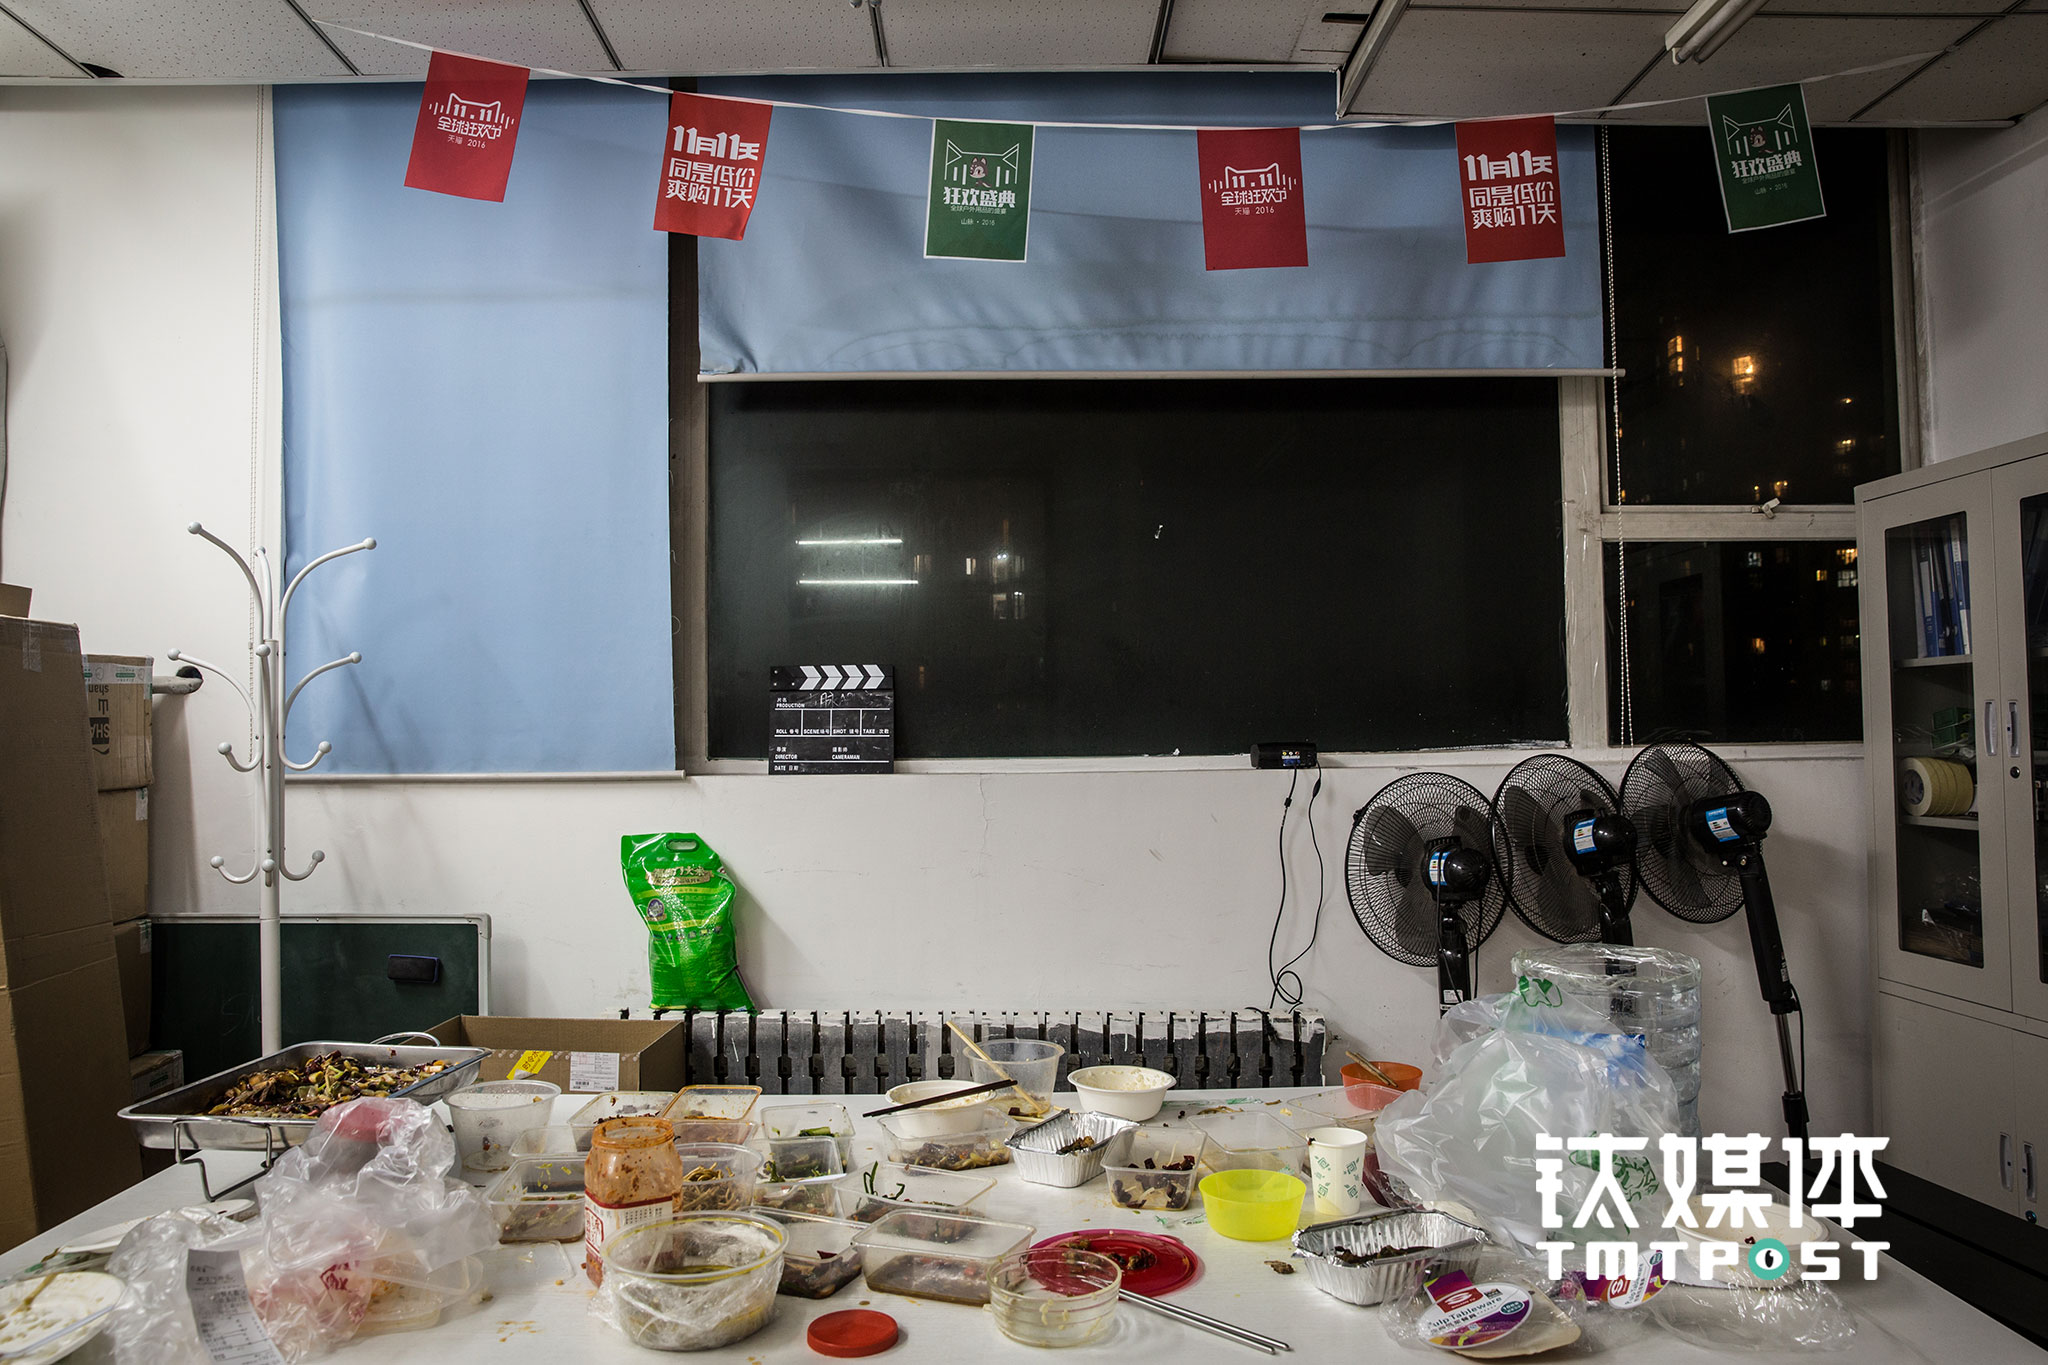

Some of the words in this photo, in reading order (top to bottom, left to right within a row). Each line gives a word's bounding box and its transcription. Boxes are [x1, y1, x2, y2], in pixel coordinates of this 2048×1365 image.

[453, 104, 493, 122] 11.11
[437, 116, 502, 140] 全球狂欢节
[467, 139, 486, 149] 2016
[673, 125, 760, 161] 11月11天
[668, 157, 755, 188] 同是低价
[1463, 149, 1553, 181] 11月11天
[1731, 150, 1802, 178] 狂欢盛典
[1232, 173, 1273, 188] 11.11
[665, 179, 753, 209] 爽购11天
[943, 186, 1016, 208] 狂欢盛典
[1221, 187, 1288, 206] 全球狂欢节
[1469, 181, 1554, 208] 同是低价
[1255, 206, 1275, 215] 2016
[1471, 203, 1557, 229] 爽购11天
[1449, 1297, 1502, 1319] Tableware
